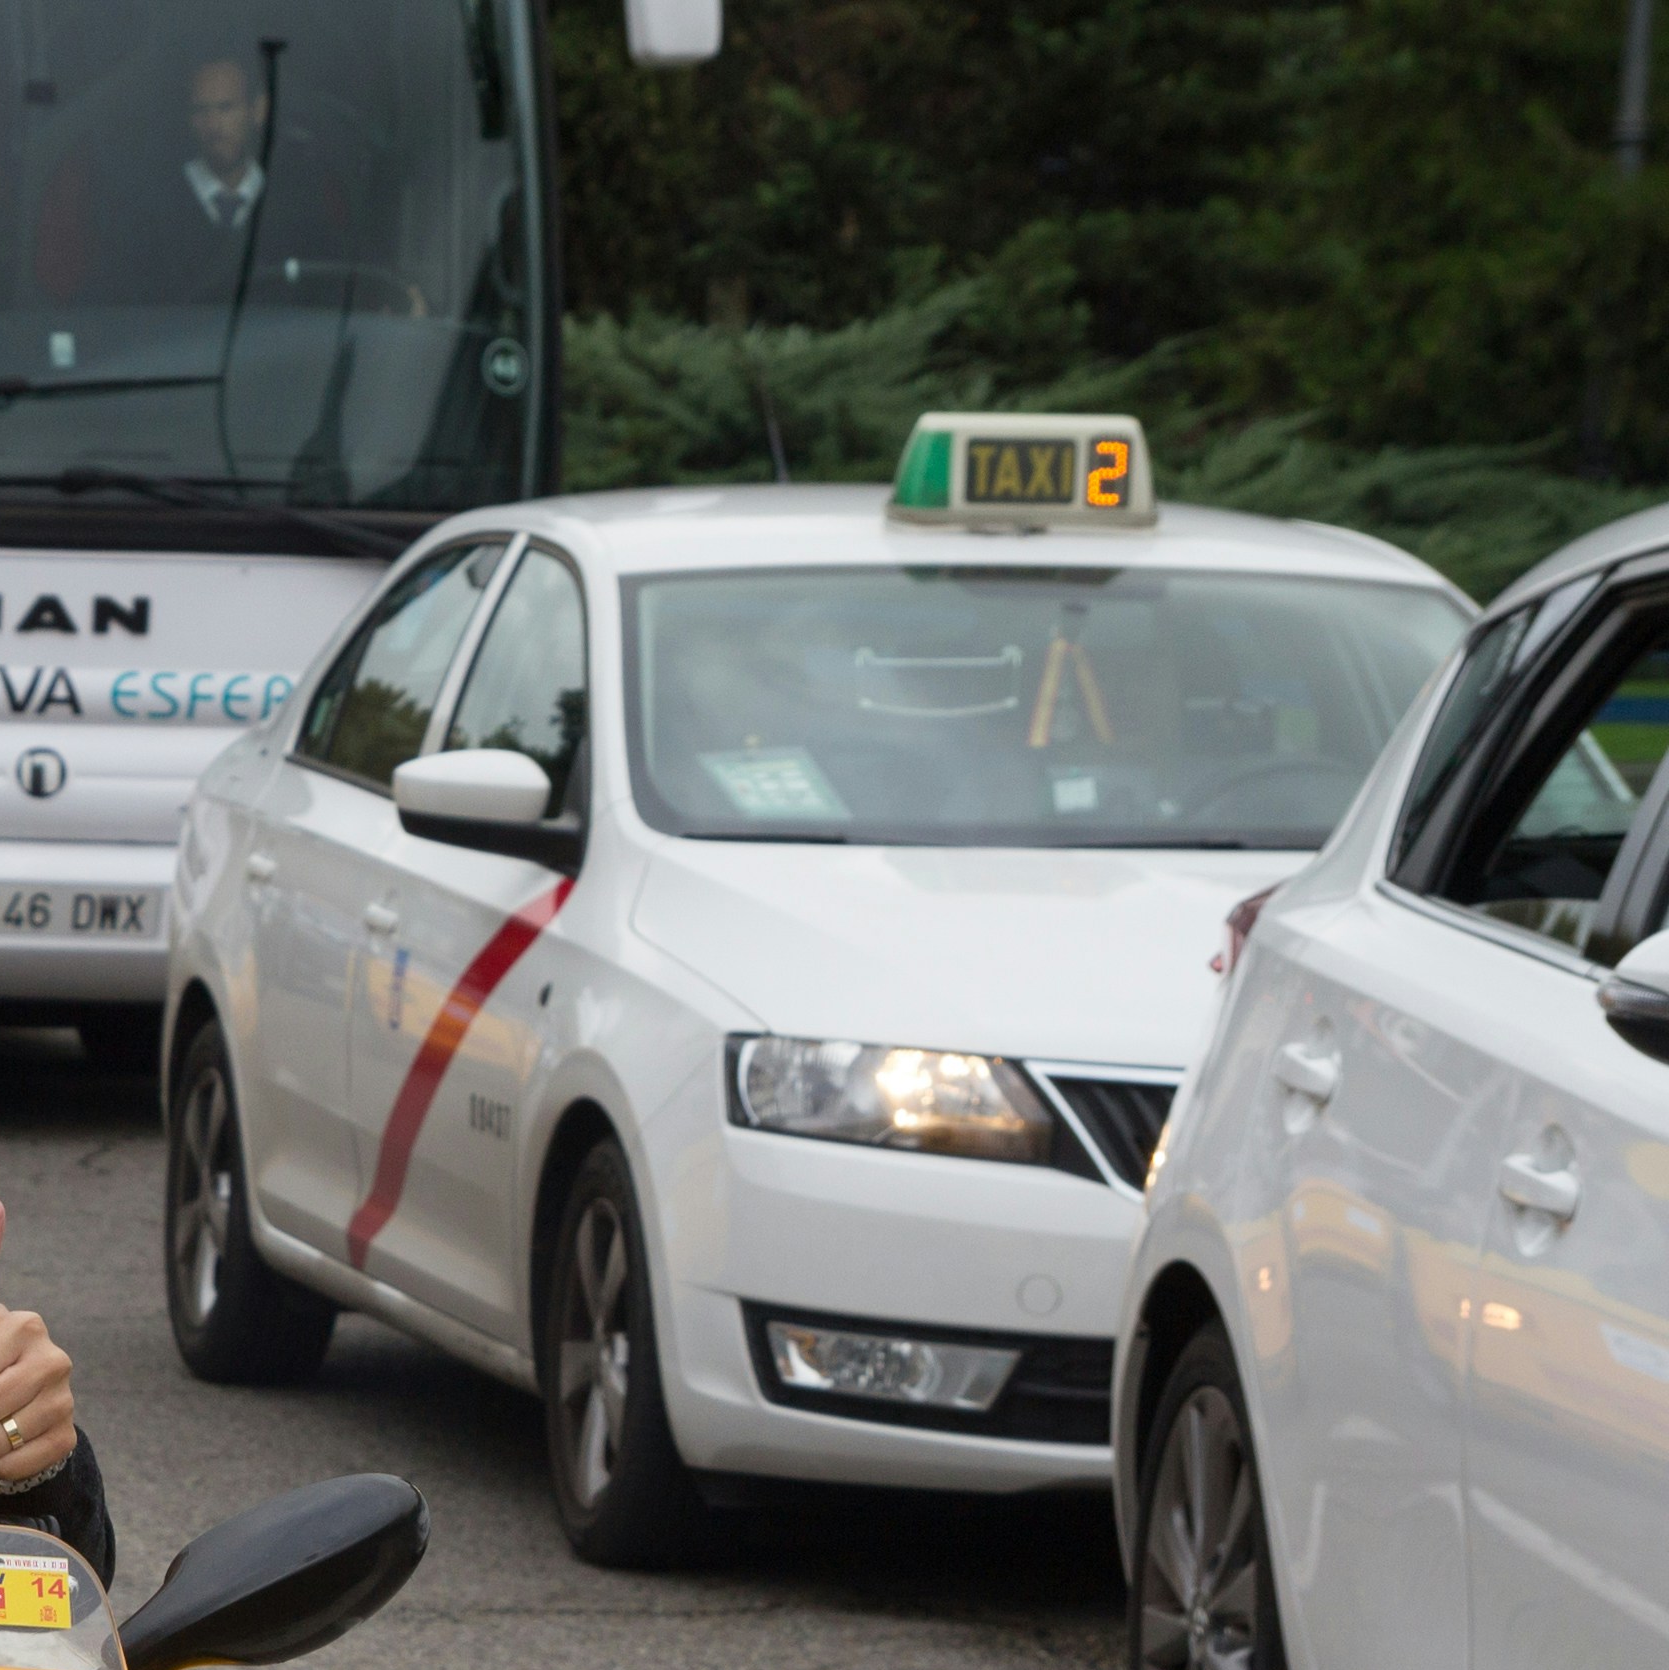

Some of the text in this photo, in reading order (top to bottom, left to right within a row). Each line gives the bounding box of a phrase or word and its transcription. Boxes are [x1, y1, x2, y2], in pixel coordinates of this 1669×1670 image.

[972, 440, 1130, 507] TAXI 2
[71, 892, 146, 932] DWX
[31, 1577, 67, 1599] 14
